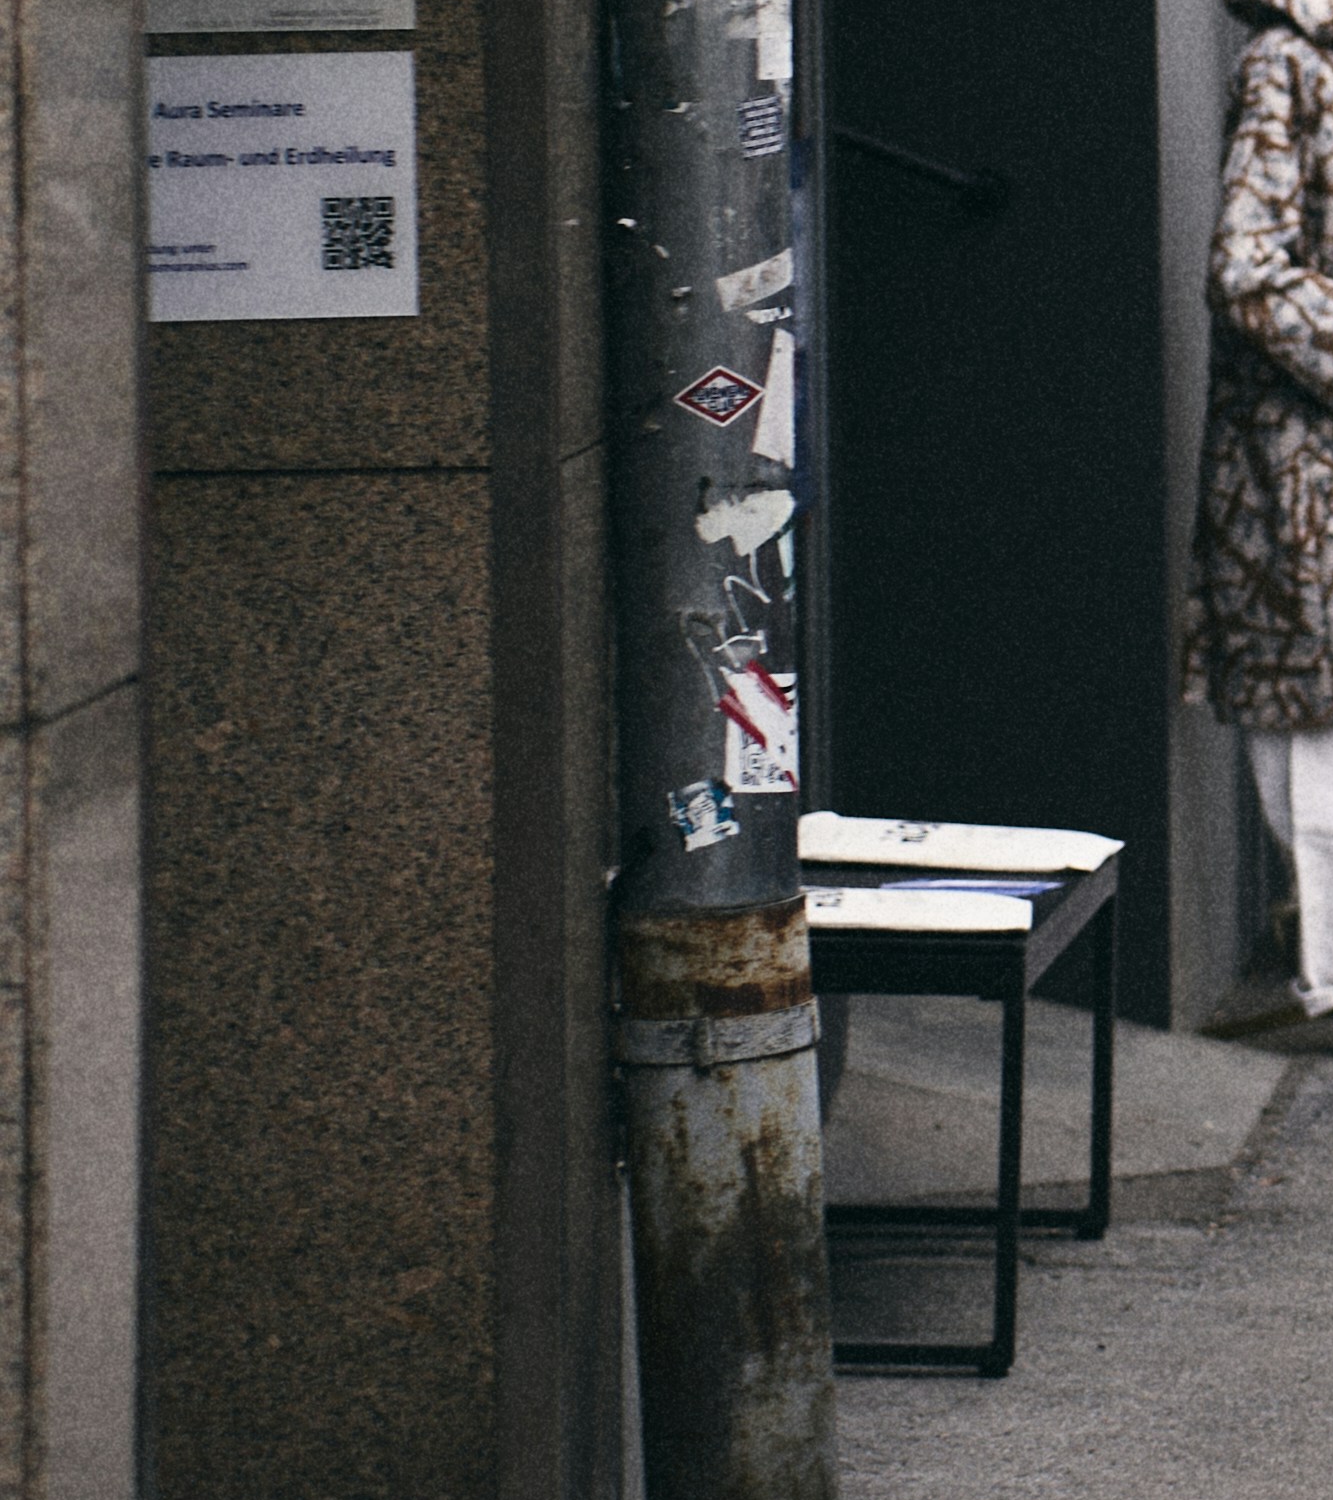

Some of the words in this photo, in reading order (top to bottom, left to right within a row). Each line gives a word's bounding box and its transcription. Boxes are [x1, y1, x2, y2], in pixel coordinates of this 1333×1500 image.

[153, 101, 203, 120] Aura
[207, 99, 306, 119] Seminare
[166, 150, 234, 168] Raum-
[239, 147, 280, 167] und
[285, 146, 397, 168] Erdheilung
